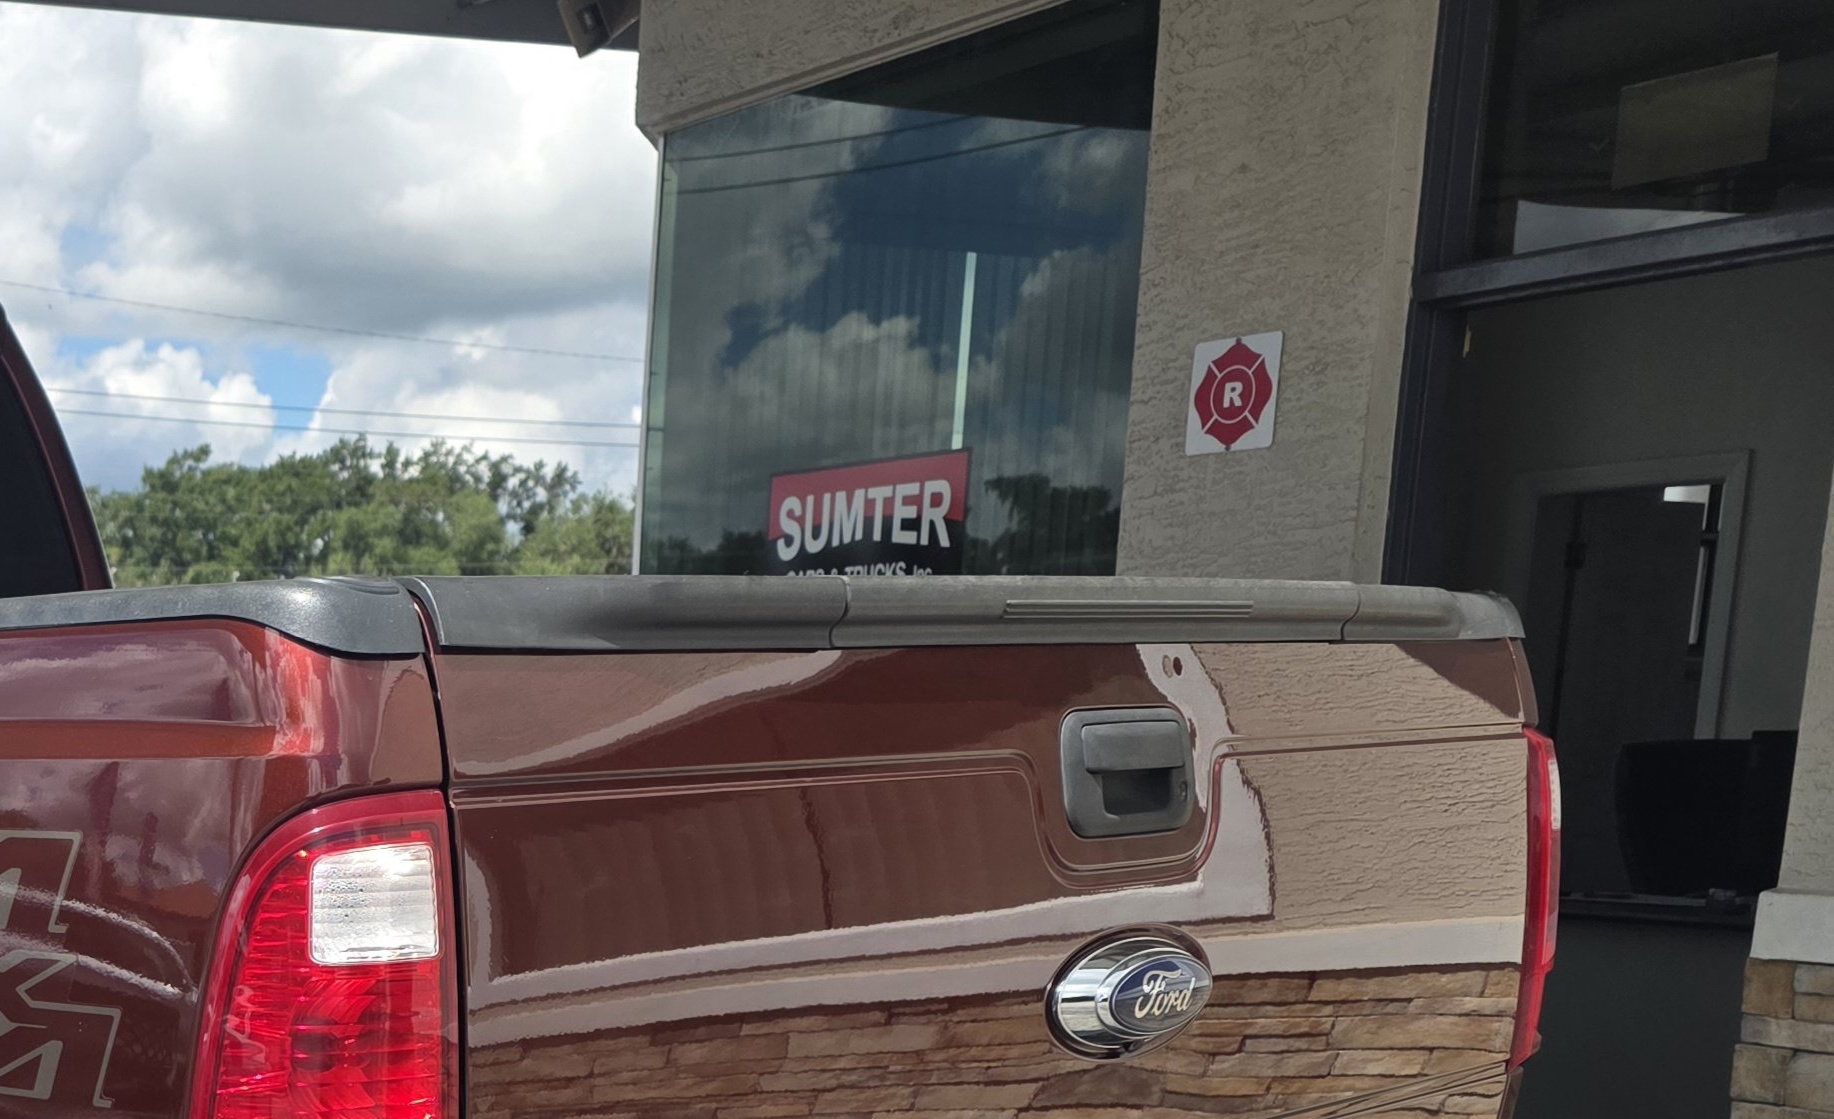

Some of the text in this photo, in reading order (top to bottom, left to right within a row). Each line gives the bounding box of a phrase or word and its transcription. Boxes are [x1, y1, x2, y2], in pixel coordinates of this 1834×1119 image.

[1222, 381, 1244, 409] R
[776, 479, 952, 562] SUMTER
[1134, 968, 1196, 1019] Ford
